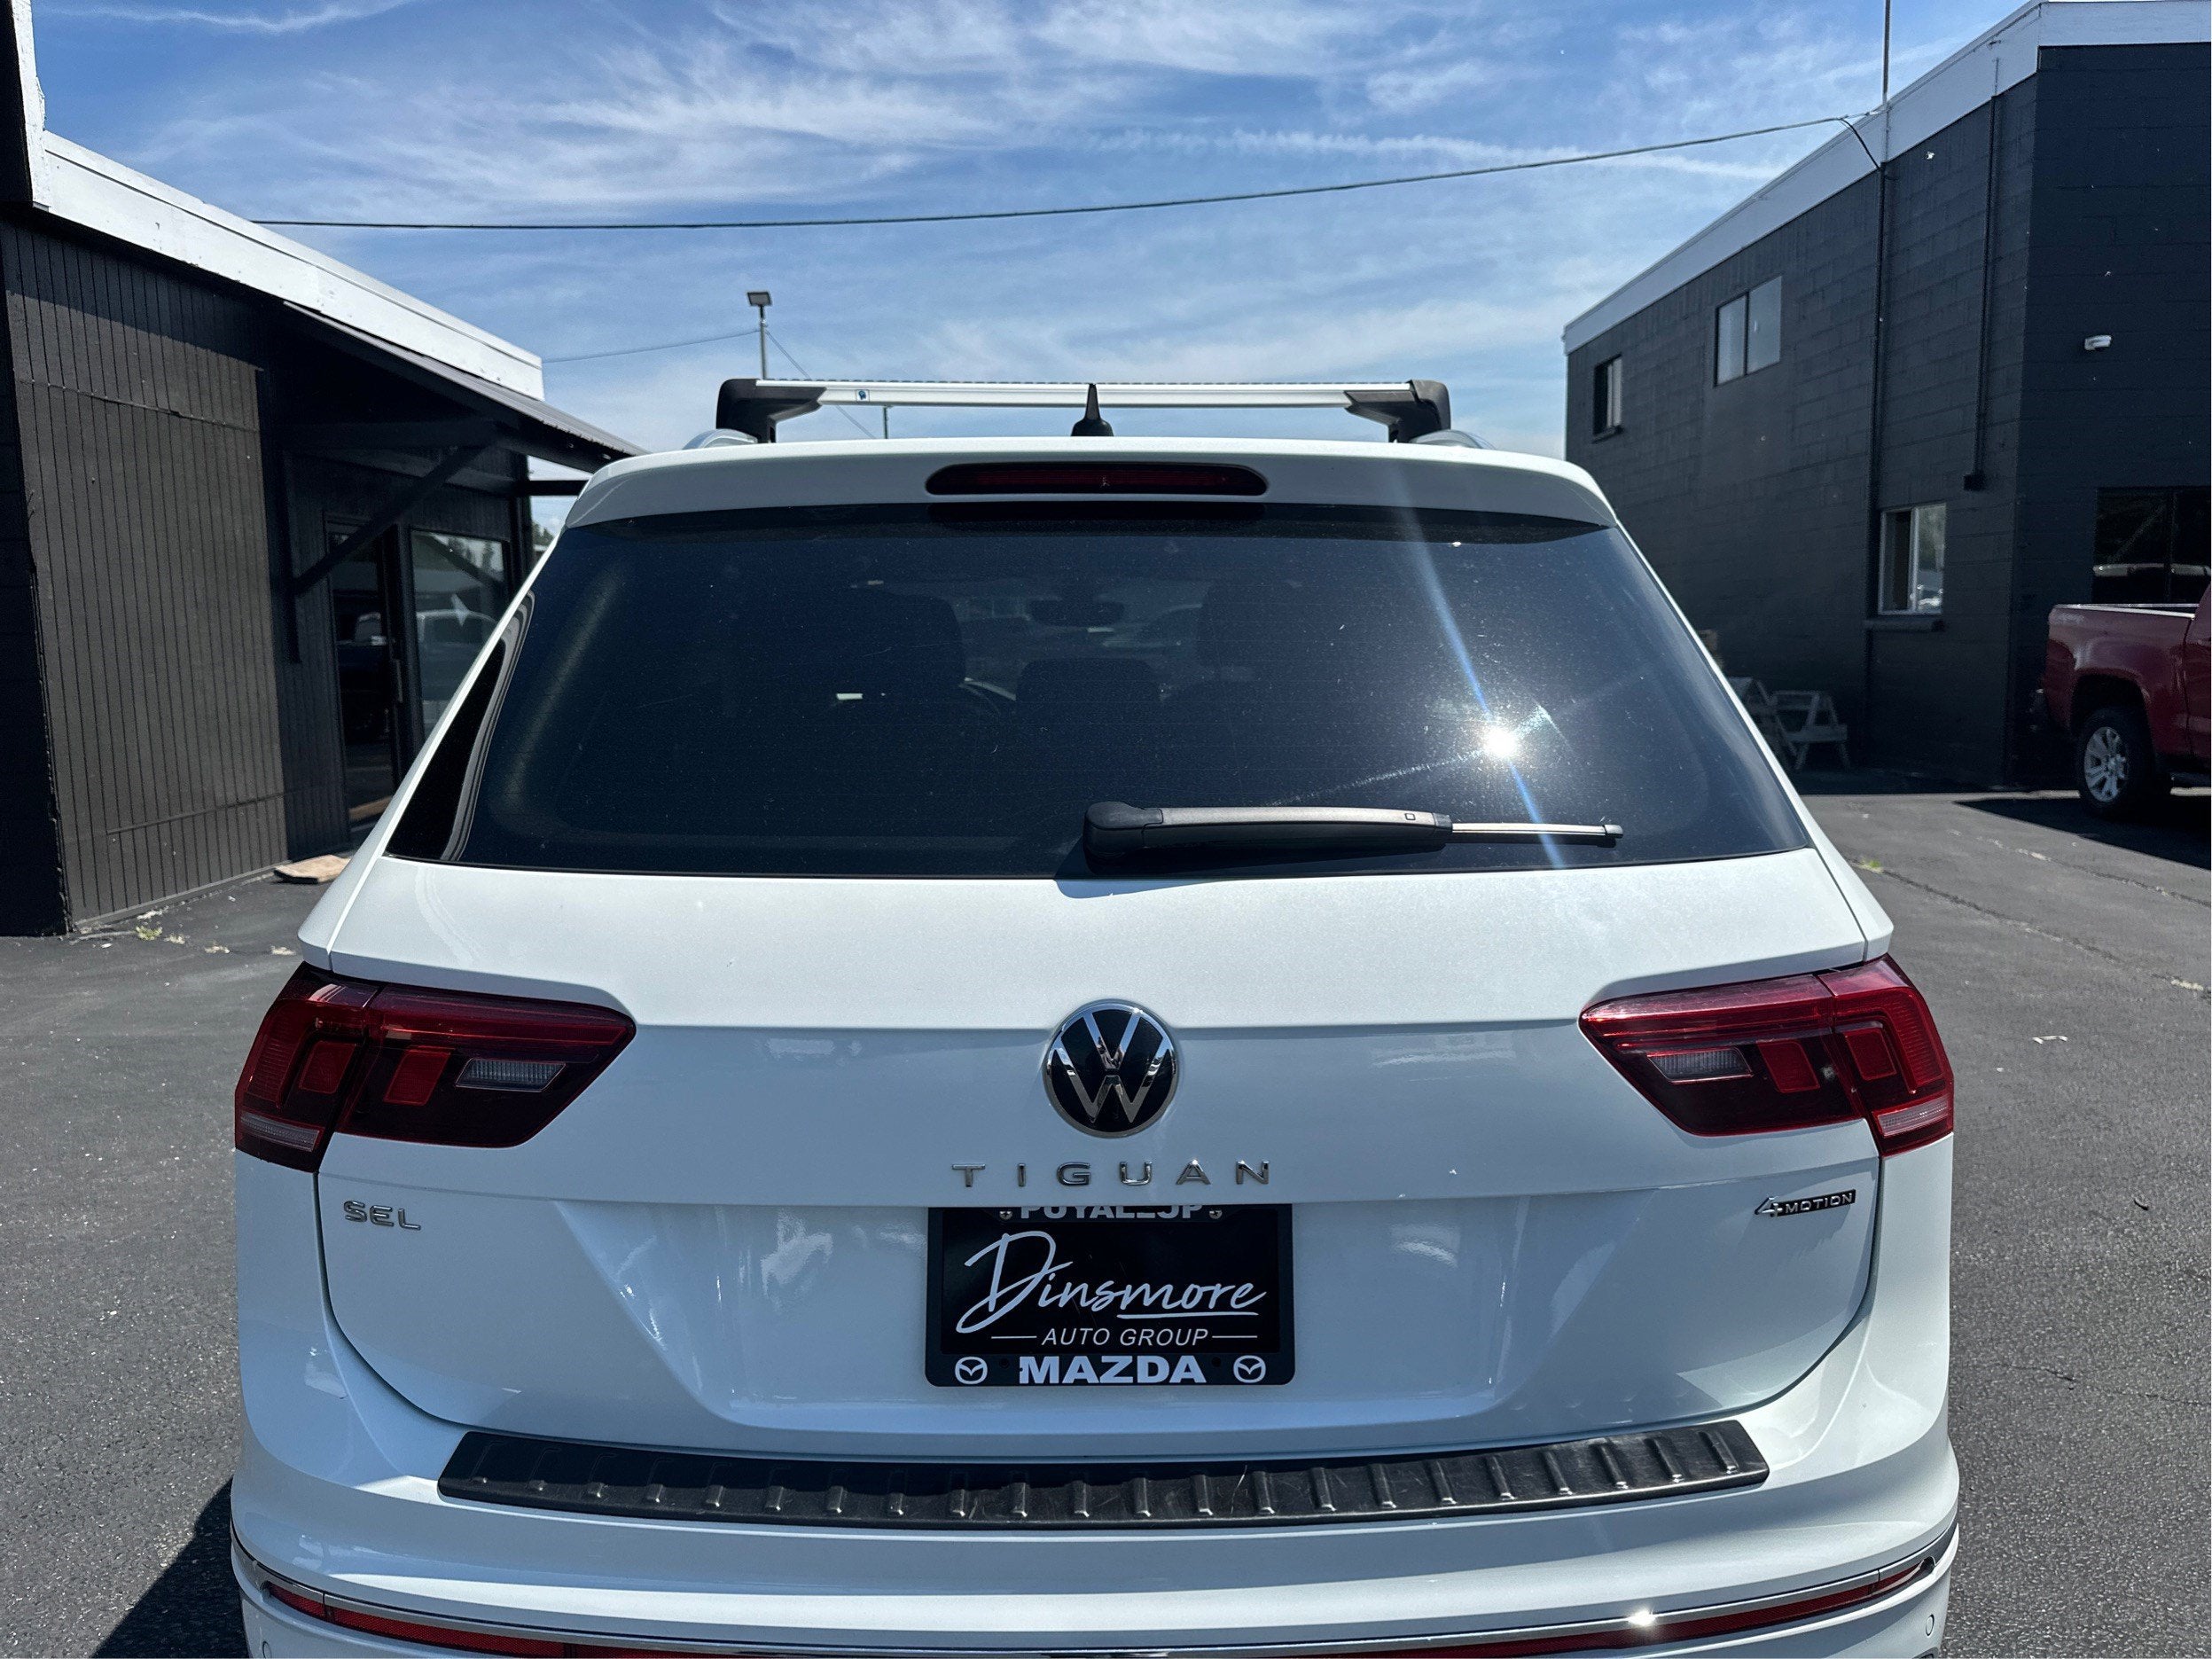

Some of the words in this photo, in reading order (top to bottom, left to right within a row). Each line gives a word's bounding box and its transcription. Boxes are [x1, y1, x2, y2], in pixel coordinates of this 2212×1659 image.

[951, 1159, 1270, 1188] TIGUAN
[343, 1200, 421, 1232] SEL
[1755, 1189, 1856, 1217] 4MOTION
[956, 1231, 1267, 1333] Dinsmore
[1041, 1327, 1111, 1346] AUTO
[1120, 1327, 1208, 1346] GROUP
[1019, 1355, 1207, 1384] MAZDA
